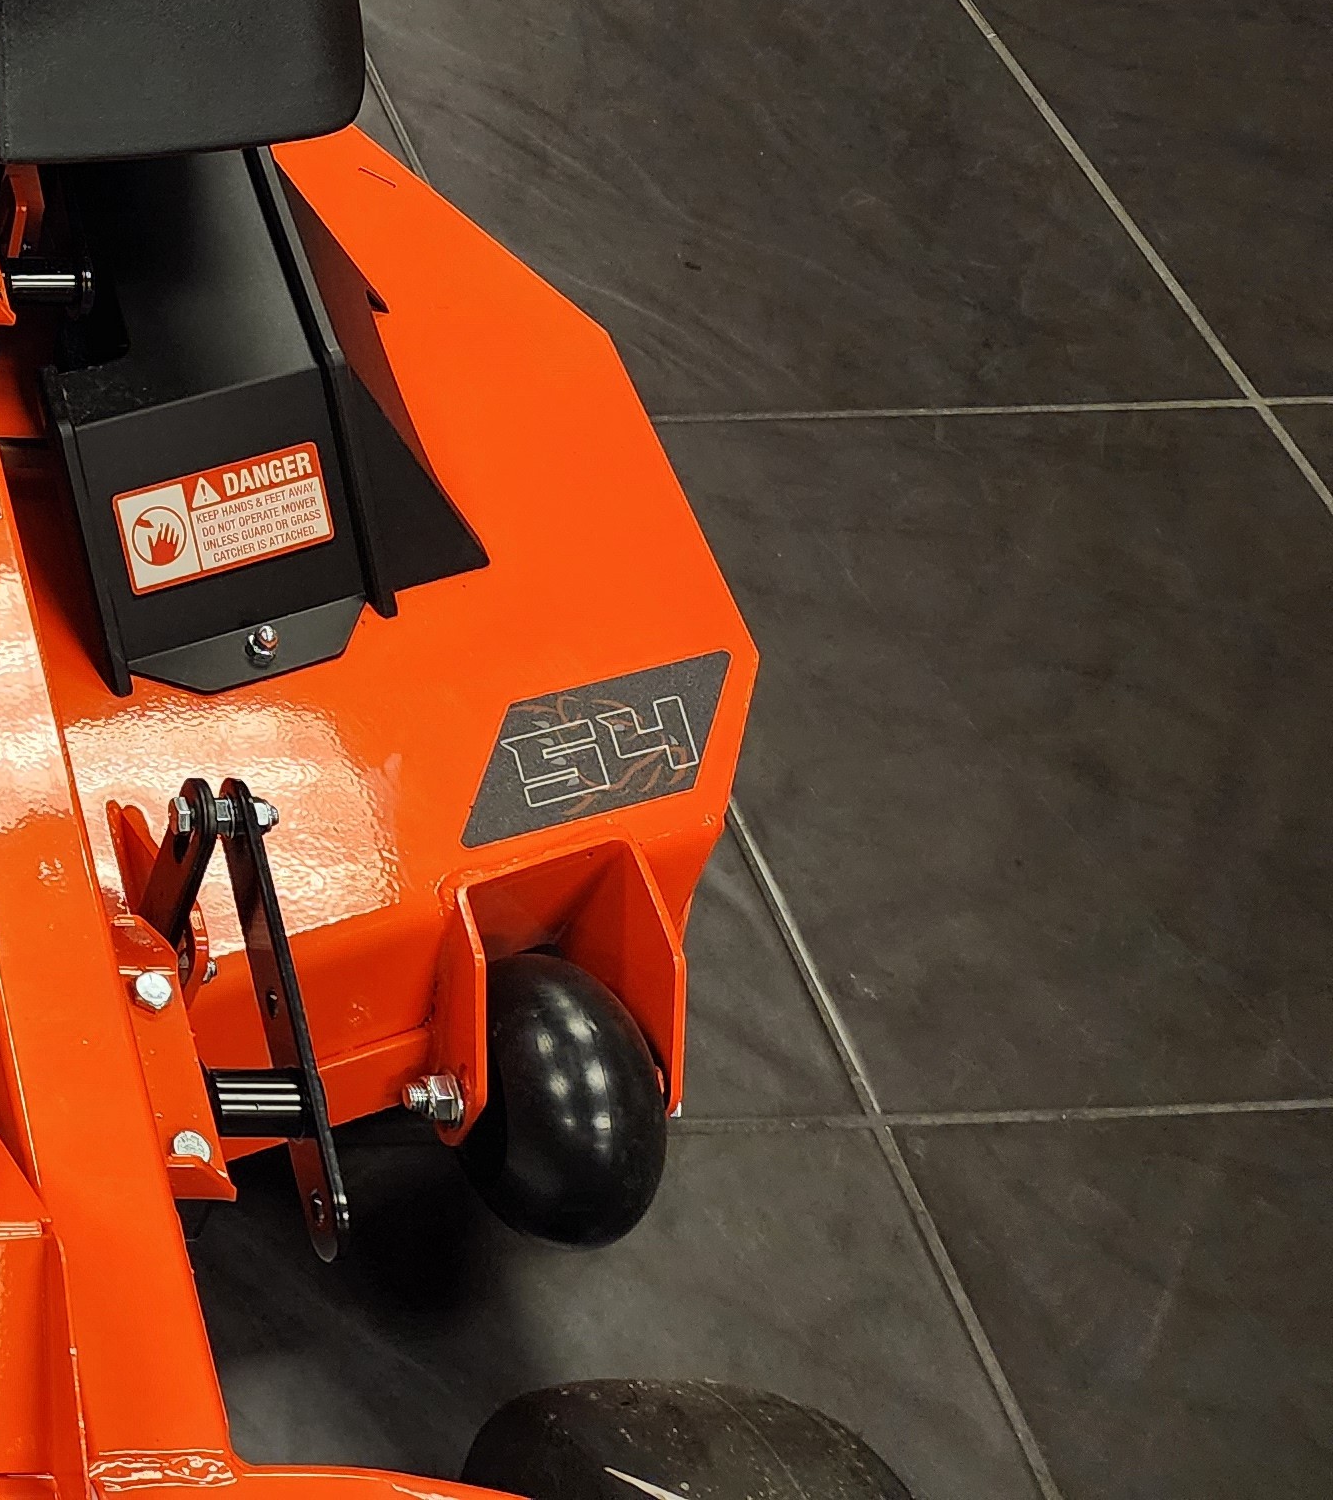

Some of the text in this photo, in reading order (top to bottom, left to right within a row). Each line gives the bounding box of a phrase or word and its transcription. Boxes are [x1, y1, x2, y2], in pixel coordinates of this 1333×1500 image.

[222, 452, 313, 497] DANGER
[195, 481, 316, 525] KEEP HANDS & FEET AWAY.
[202, 496, 317, 538] DO NOT OPERATE MOWER
[203, 509, 321, 552] UNLESS GUARD OR GRASS
[213, 525, 318, 563] CATCHER IS ATTACHED.
[500, 695, 699, 808] 54
